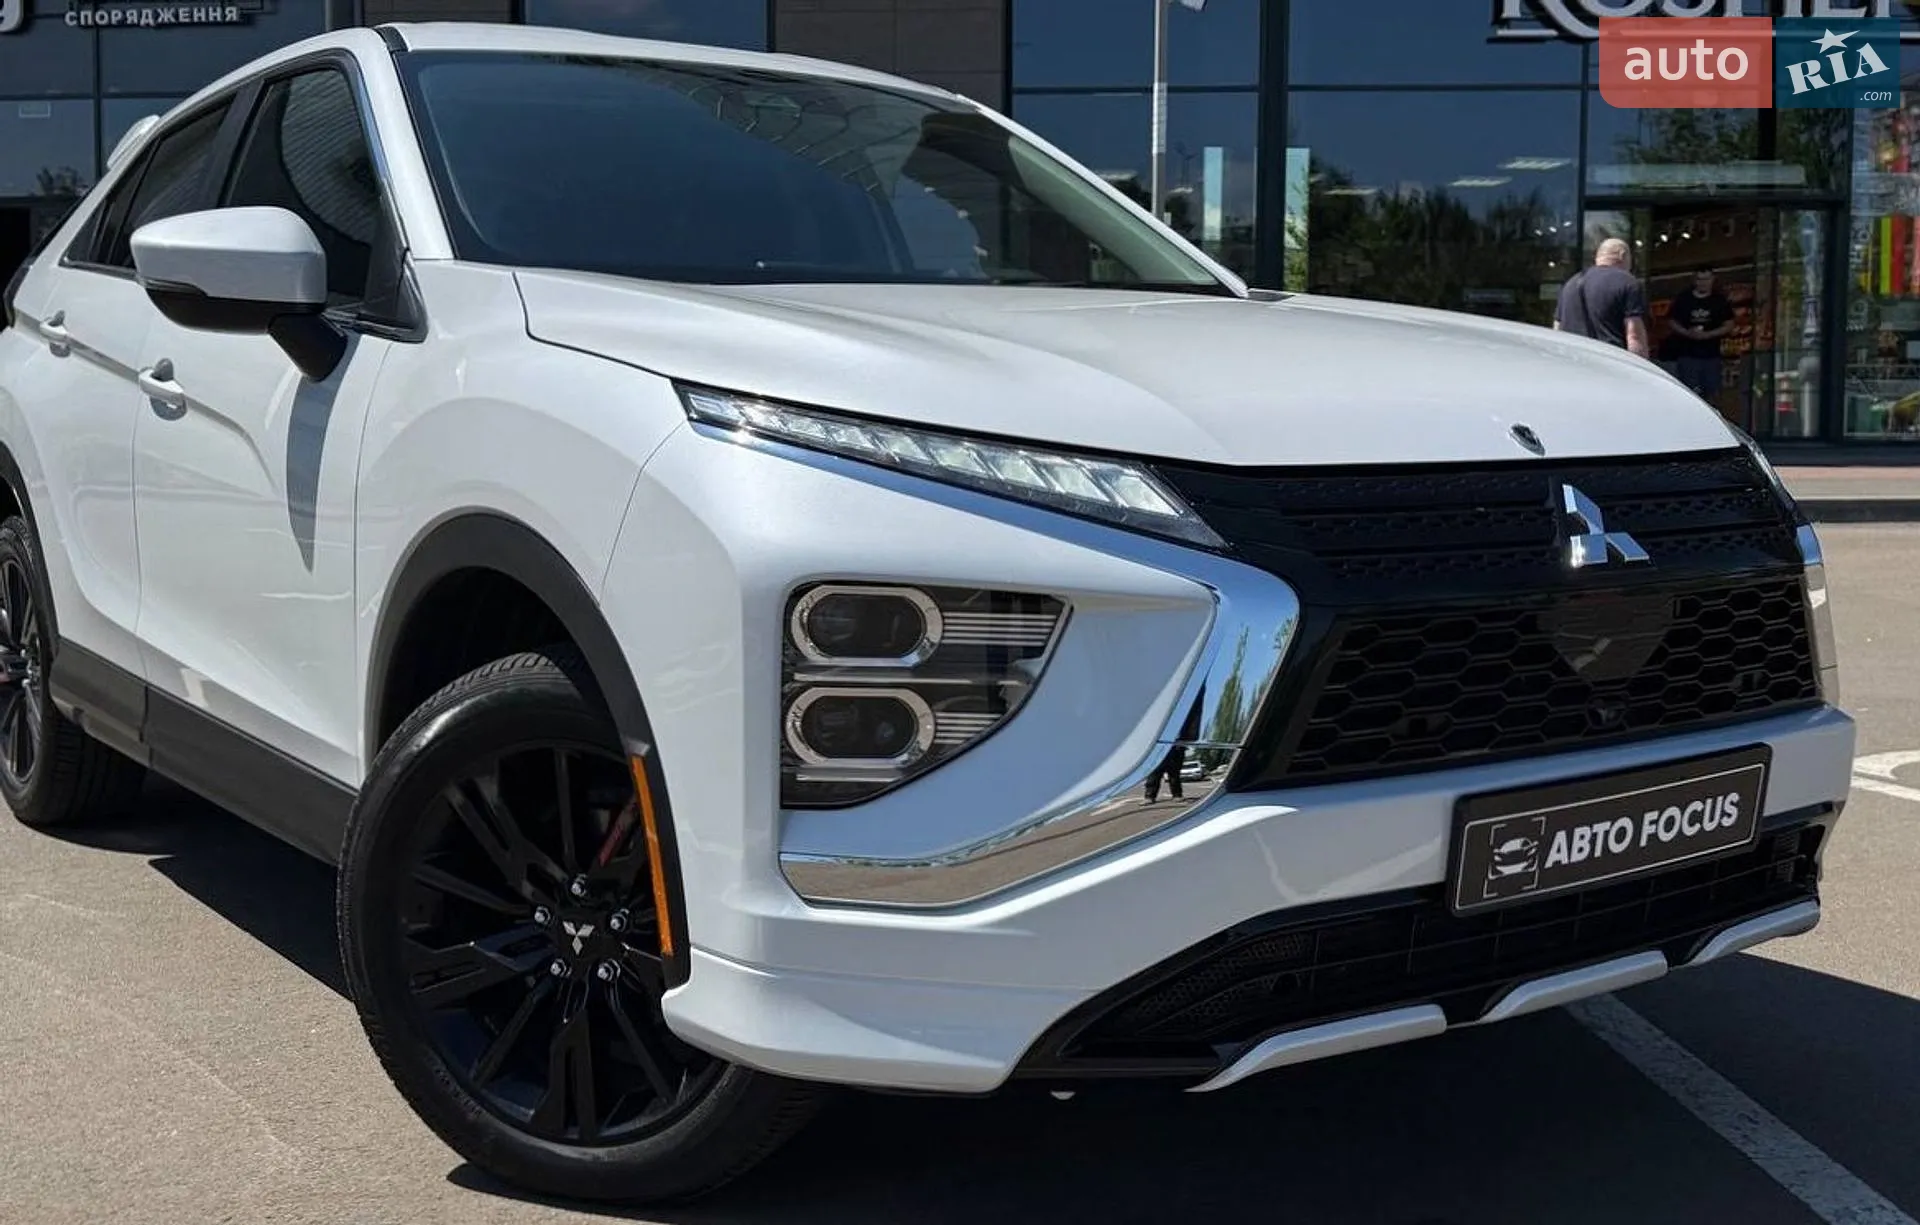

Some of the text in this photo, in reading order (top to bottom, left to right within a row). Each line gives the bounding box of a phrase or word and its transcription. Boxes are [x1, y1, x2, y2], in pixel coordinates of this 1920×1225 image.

[64, 6, 239, 27] СПОРЯДЖЕННЯ
[1544, 792, 1740, 869] АВТО FOCUS
